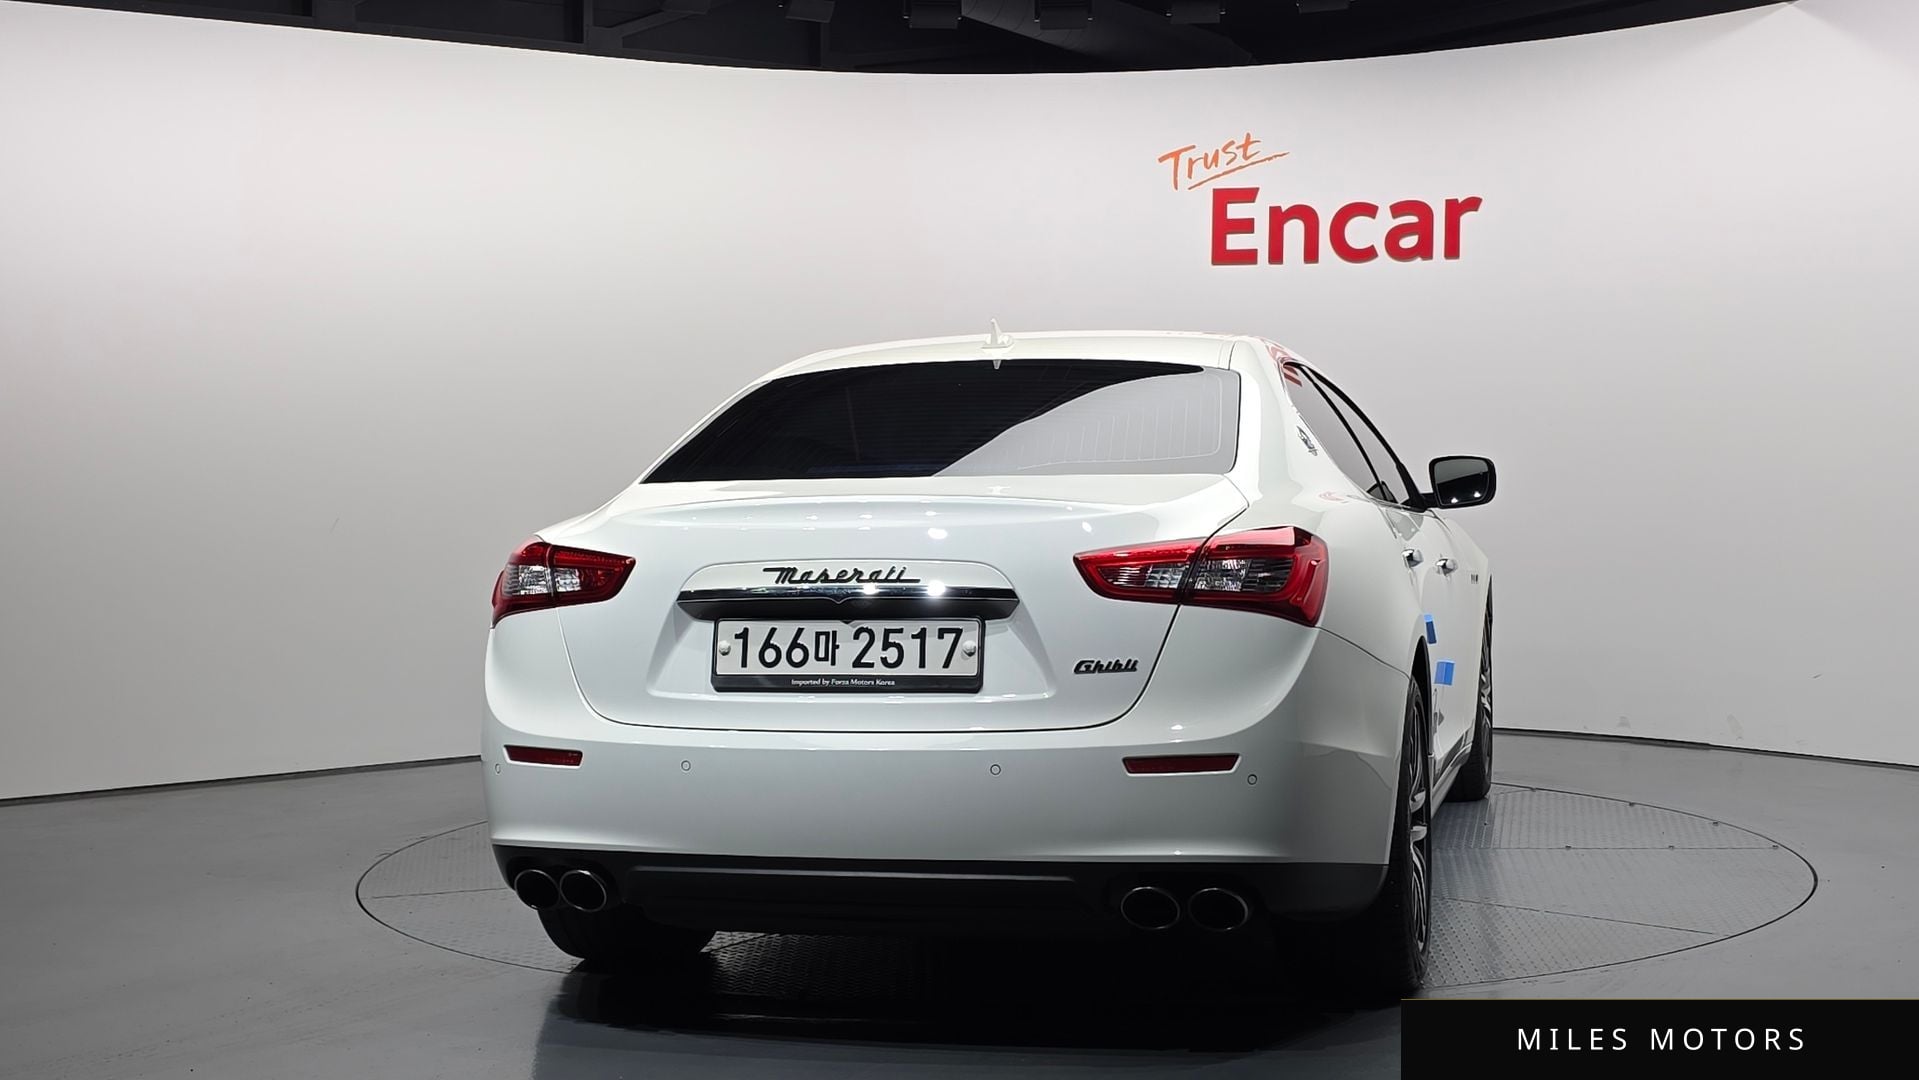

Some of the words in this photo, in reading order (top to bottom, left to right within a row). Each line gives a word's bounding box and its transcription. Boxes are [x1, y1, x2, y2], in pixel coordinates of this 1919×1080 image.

[1158, 132, 1262, 191] Trust
[1211, 187, 1483, 266] Encar
[763, 566, 921, 584] Maserati
[734, 626, 840, 669] 166마
[851, 626, 964, 669] 2517
[1073, 658, 1139, 675] Ghibli
[791, 678, 821, 687] Imported
[821, 678, 830, 687] by
